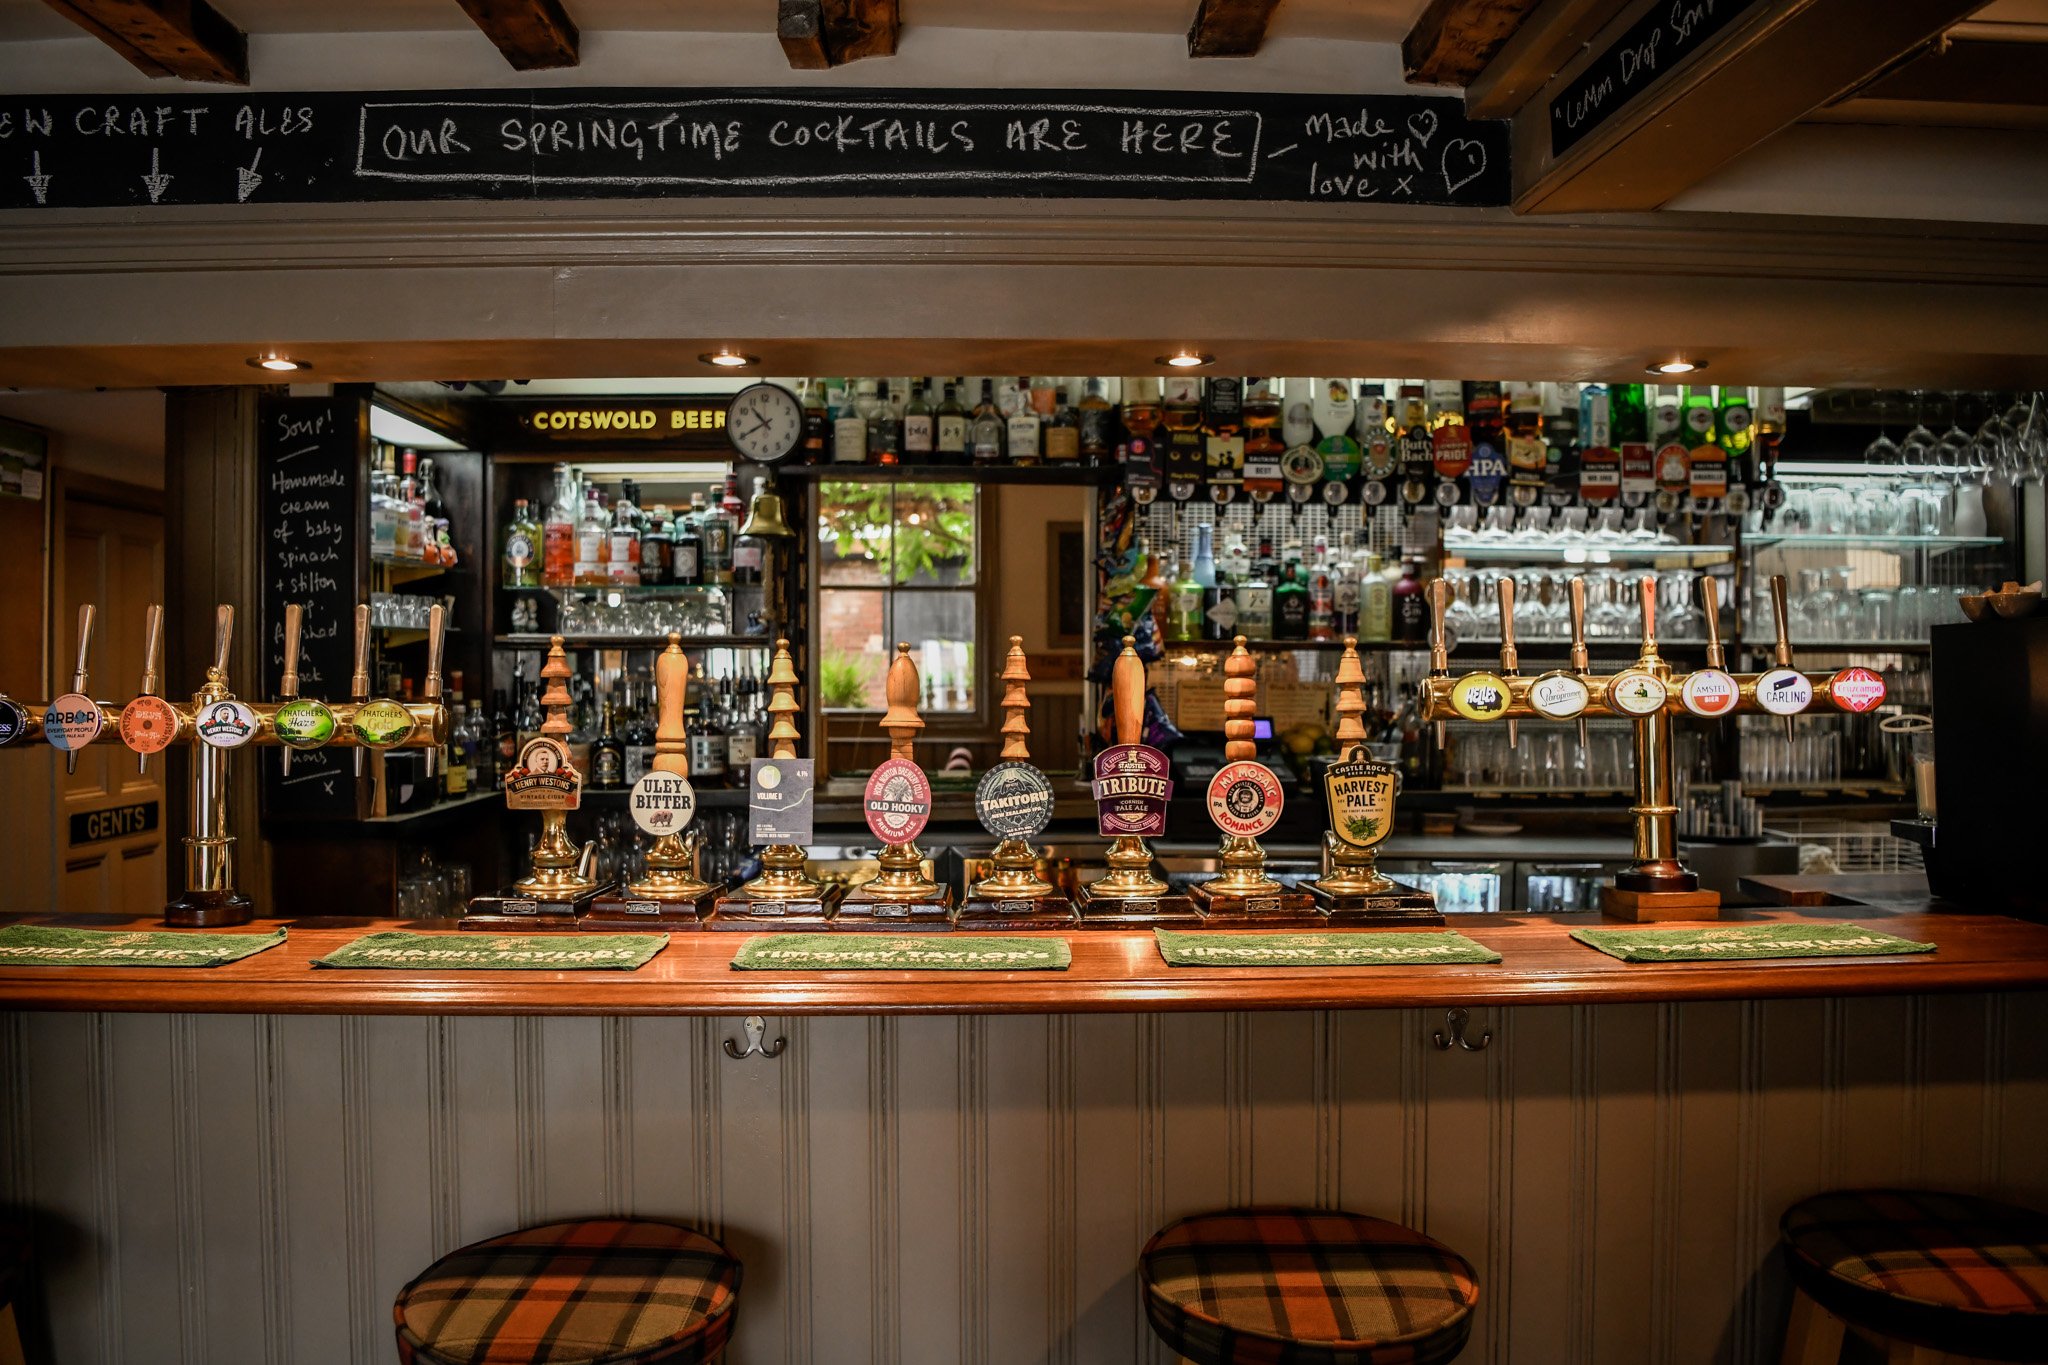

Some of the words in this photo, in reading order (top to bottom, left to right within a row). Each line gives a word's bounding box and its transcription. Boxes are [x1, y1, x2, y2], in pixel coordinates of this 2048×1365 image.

[1620, 28, 1662, 86] Drop
[76, 106, 209, 137] CRAFT
[236, 106, 313, 139] ALES
[1305, 108, 1394, 143] Made
[382, 117, 471, 160] OUR
[500, 112, 741, 160] SPRINGTIME
[769, 114, 975, 153] COCKTAILS
[1006, 118, 1087, 151] ARE
[1122, 119, 1242, 157] HERE
[1353, 138, 1423, 172] with
[1310, 161, 1379, 197] love
[278, 409, 335, 441] Soup!
[533, 410, 657, 430] COTSWOLD
[1436, 450, 1468, 461] PRIDE
[272, 469, 345, 494] Homemade
[279, 500, 330, 515] cream
[273, 520, 294, 543] of
[306, 520, 343, 544] baby
[278, 546, 339, 568] spinach
[290, 572, 337, 593] stilton
[1696, 686, 1725, 694] AMSTEL
[1766, 691, 1806, 703] CARLING
[284, 709, 324, 718] THATCHERS
[288, 718, 316, 728] Haze
[362, 709, 403, 718] THATCHERS
[1335, 764, 1364, 774] CASTLE
[1366, 764, 1387, 773] ROCK
[515, 778, 537, 790] HENRY
[538, 777, 570, 790] WESTONS
[643, 779, 683, 793] ULEY
[1100, 777, 1167, 797] TRIBUTE
[1219, 771, 1234, 789] MY
[1238, 767, 1277, 798] MOSAIC
[1334, 780, 1389, 796] HARVEST
[636, 794, 691, 809] BITTER
[871, 802, 889, 811] OLD
[892, 803, 924, 814] HOOKY
[981, 790, 1049, 811] TAKITORU
[1346, 794, 1376, 808] PALE
[87, 806, 145, 840] GENTS
[876, 817, 905, 837] PREMIUM
[905, 821, 916, 834] ALE
[1218, 811, 1264, 831] ROMANCE
[494, 948, 636, 959] TAYLOR'S
